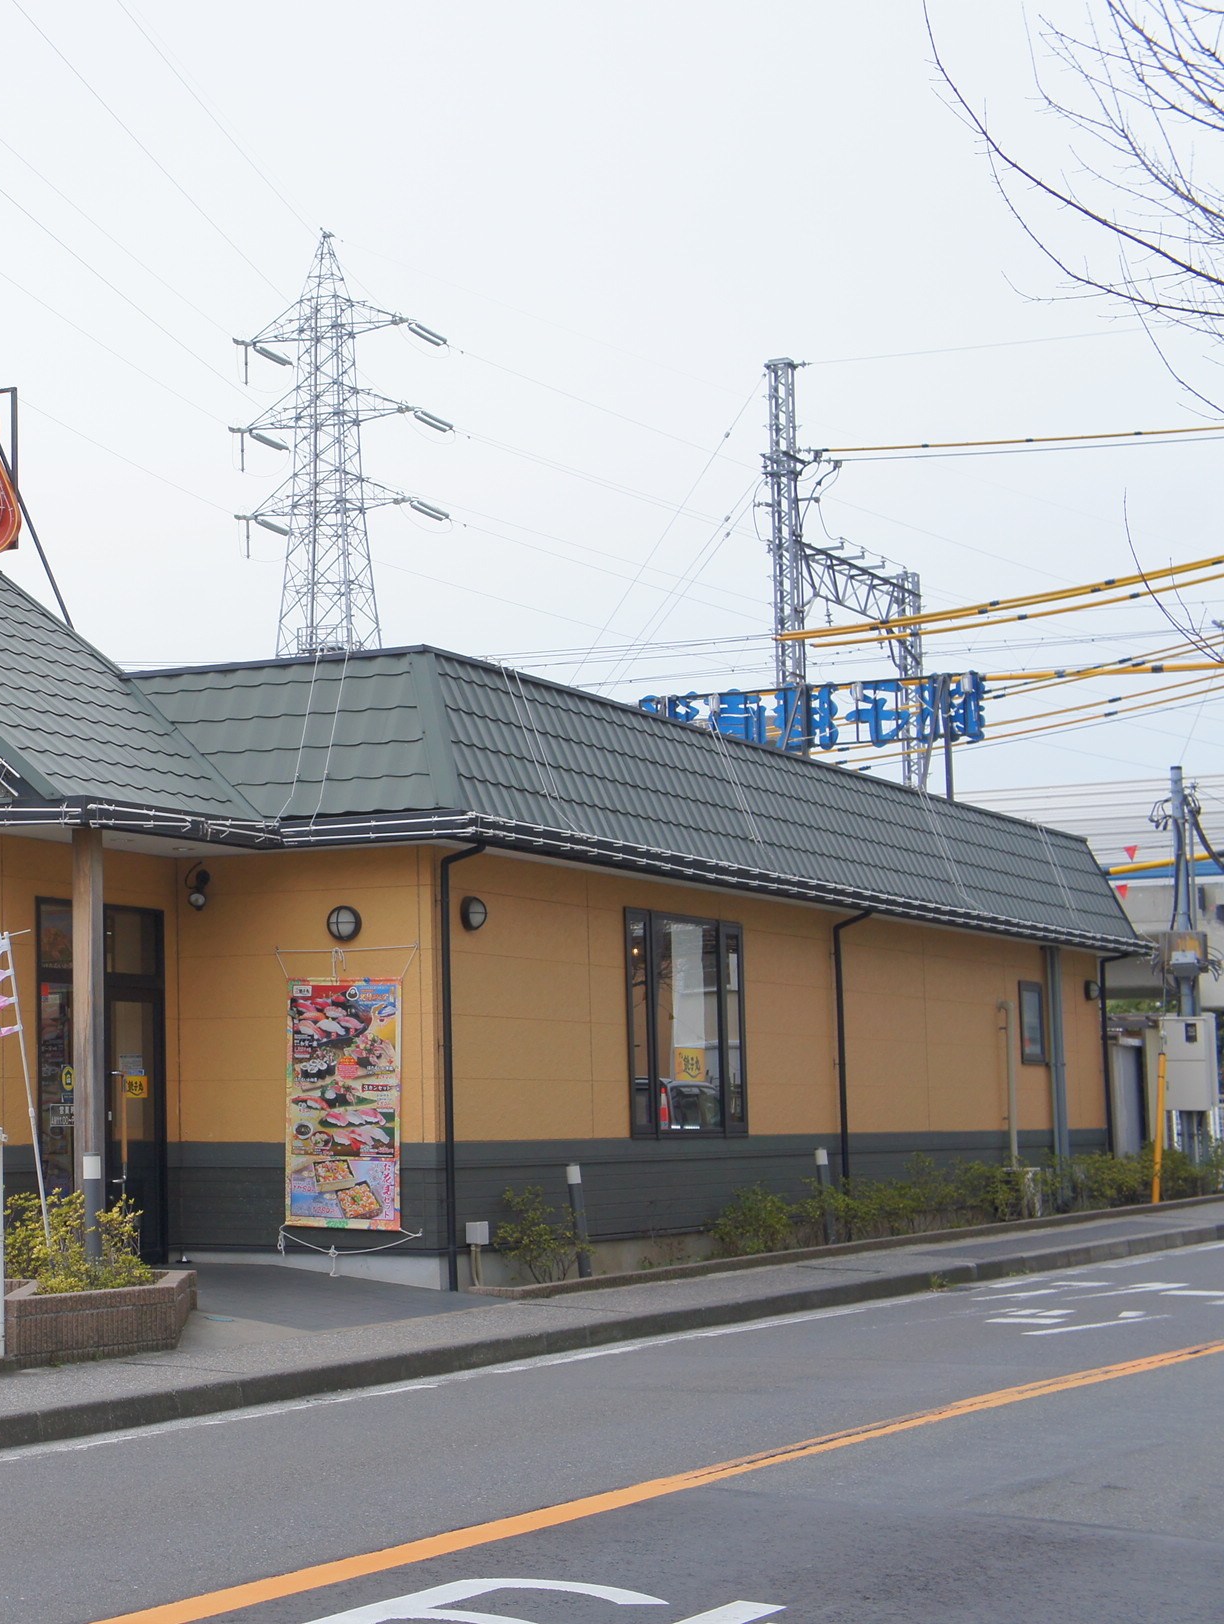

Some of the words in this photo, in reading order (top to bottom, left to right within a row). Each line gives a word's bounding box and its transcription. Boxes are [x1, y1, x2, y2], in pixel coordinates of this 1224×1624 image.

[382, 1163, 392, 1219] お花見セット
